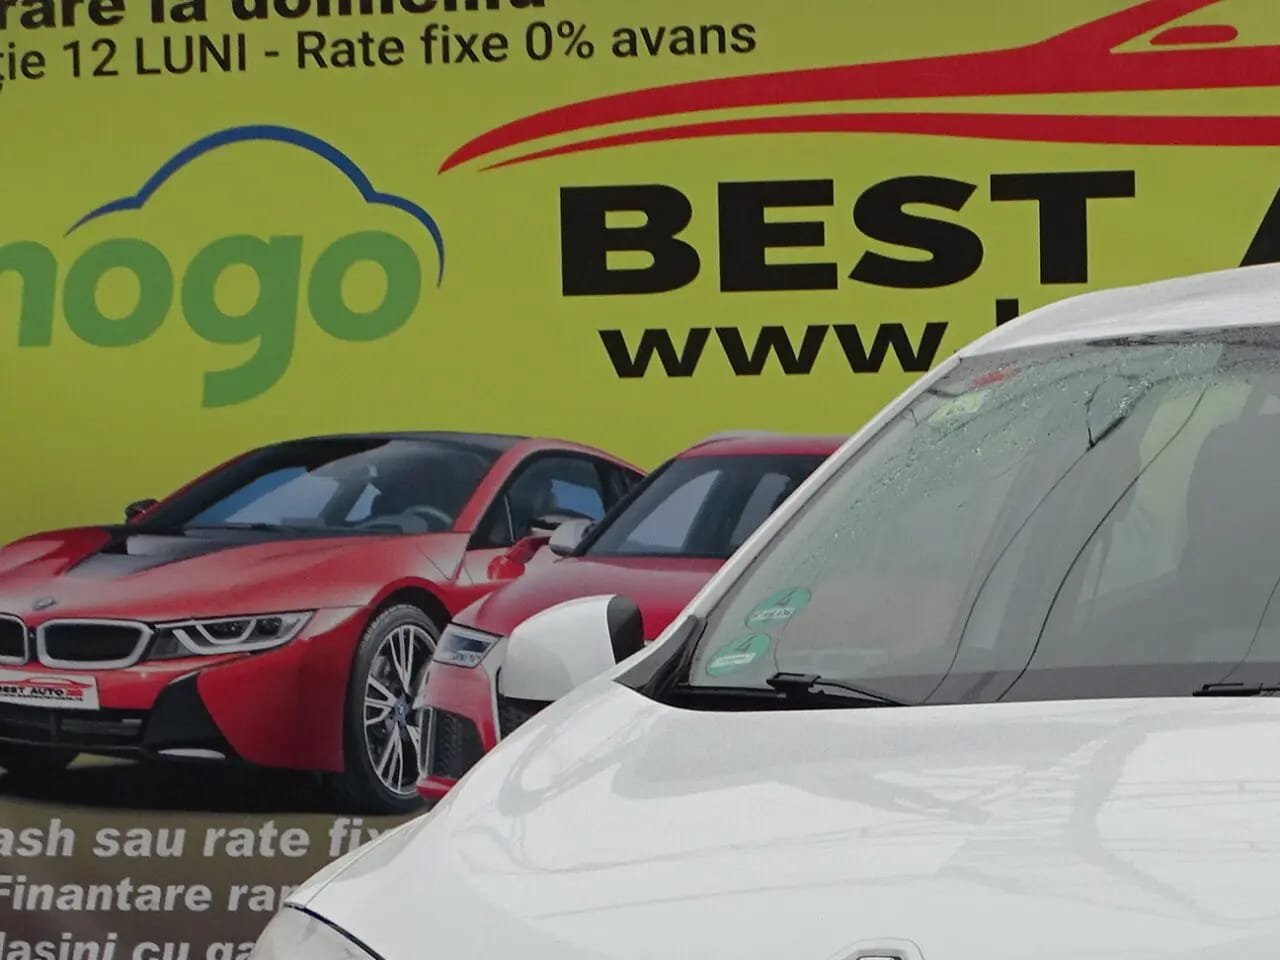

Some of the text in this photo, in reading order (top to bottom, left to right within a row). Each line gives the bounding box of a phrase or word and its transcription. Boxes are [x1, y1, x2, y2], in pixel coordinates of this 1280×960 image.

[151, 0, 208, 24] la
[63, 38, 119, 78] 12
[136, 33, 246, 76] LUNI
[297, 29, 405, 69] Rate
[420, 22, 509, 65] fixe
[525, 20, 595, 61] 0%
[611, 22, 757, 58] avans
[559, 169, 1136, 297] BEST
[93, 827, 186, 858] sau
[203, 819, 310, 858] rate
